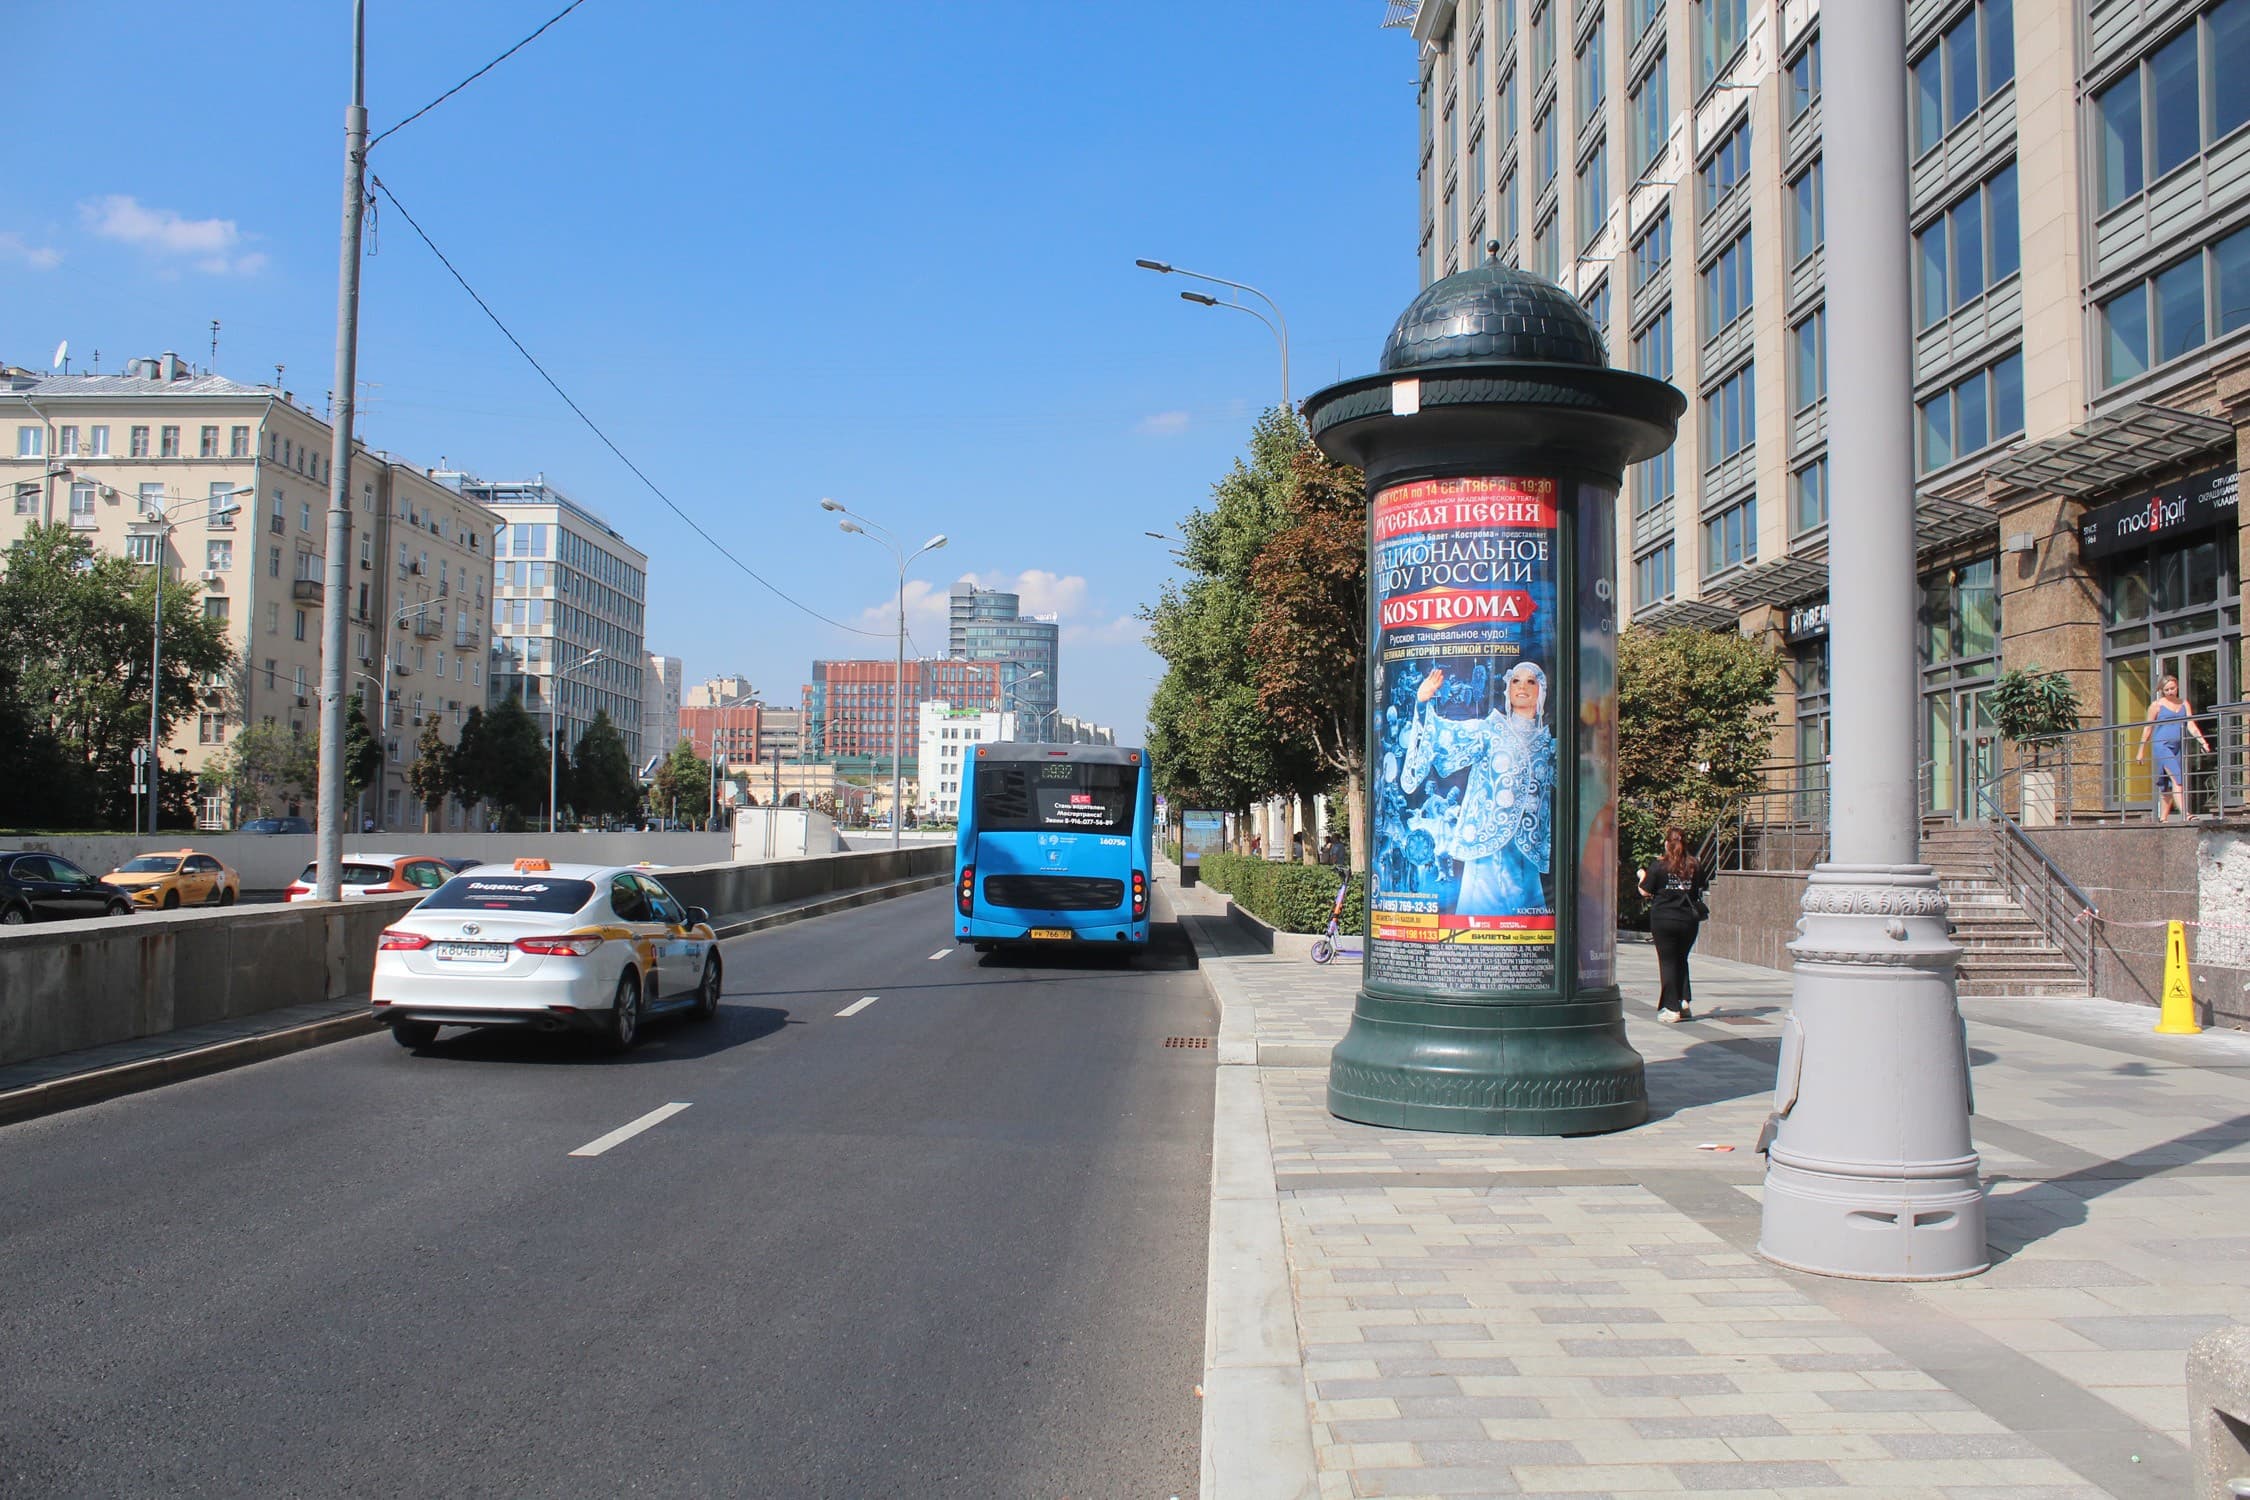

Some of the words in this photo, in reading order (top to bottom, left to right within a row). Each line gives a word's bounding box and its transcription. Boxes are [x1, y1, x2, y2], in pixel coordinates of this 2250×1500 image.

[1411, 487, 1422, 498] по
[1426, 484, 1437, 496] 14
[1441, 480, 1506, 495] СЕНТЯБРЯ
[1520, 480, 1552, 493] 19:30
[1376, 505, 1448, 539] РУССКАЯ
[1455, 502, 1540, 522] ПЕСНЯ
[1374, 540, 1549, 574] НАЦИОНАЛЬНОЕ
[1379, 567, 1415, 593] ШОУ
[1421, 561, 1533, 586] РОССИИ
[1384, 596, 1520, 624] KOSTROMA
[1389, 633, 1415, 647] Русское
[1417, 630, 1479, 642] танцевальное
[1481, 628, 1508, 641] чудо!
[1406, 646, 1441, 657] ИСТОРИЯ
[1442, 643, 1482, 655] ВЕЛИКОЙ
[1483, 643, 1520, 654] СТРАНЫ
[467, 882, 523, 891] Яндекс
[1399, 900, 1439, 913] 769-32-35
